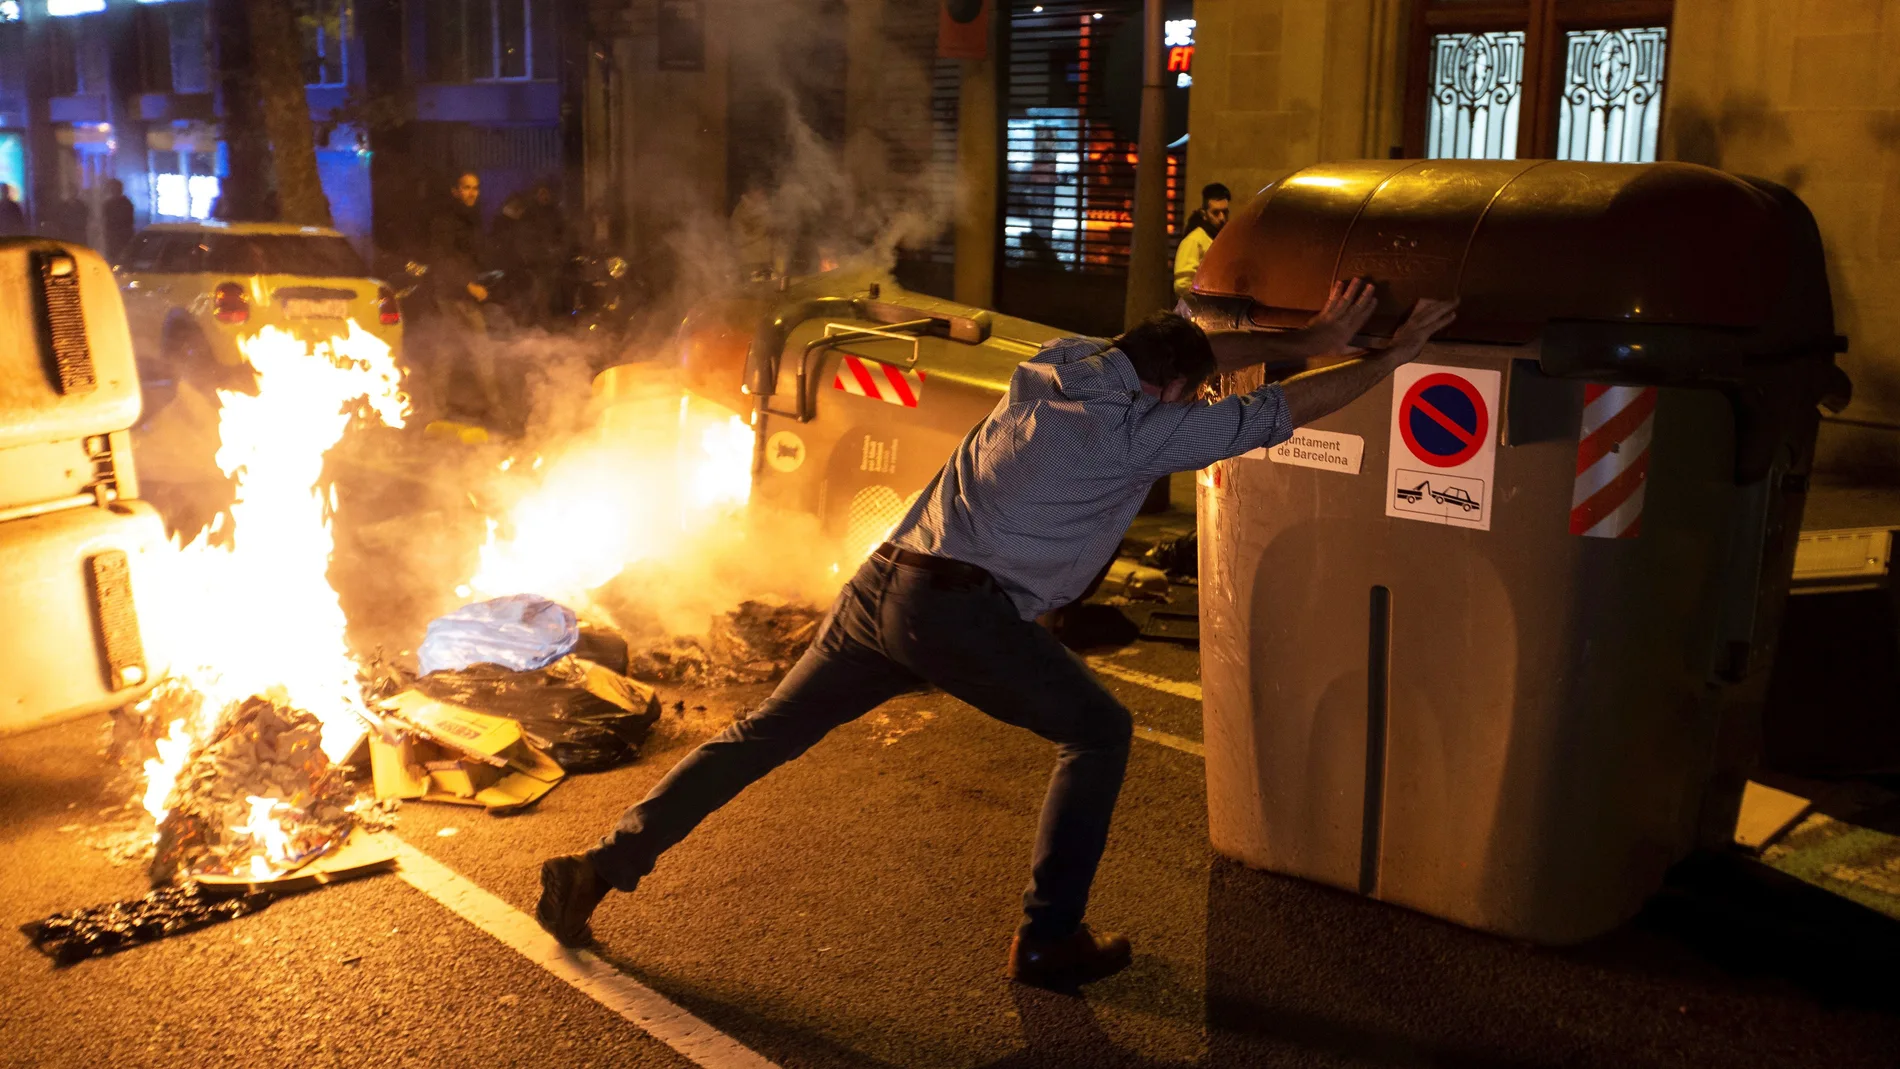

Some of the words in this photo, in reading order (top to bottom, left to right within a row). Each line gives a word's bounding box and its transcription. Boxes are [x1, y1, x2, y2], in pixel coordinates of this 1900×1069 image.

[1284, 436, 1341, 451] untament
[1277, 446, 1291, 457] de
[1293, 448, 1348, 465] Barcelona
